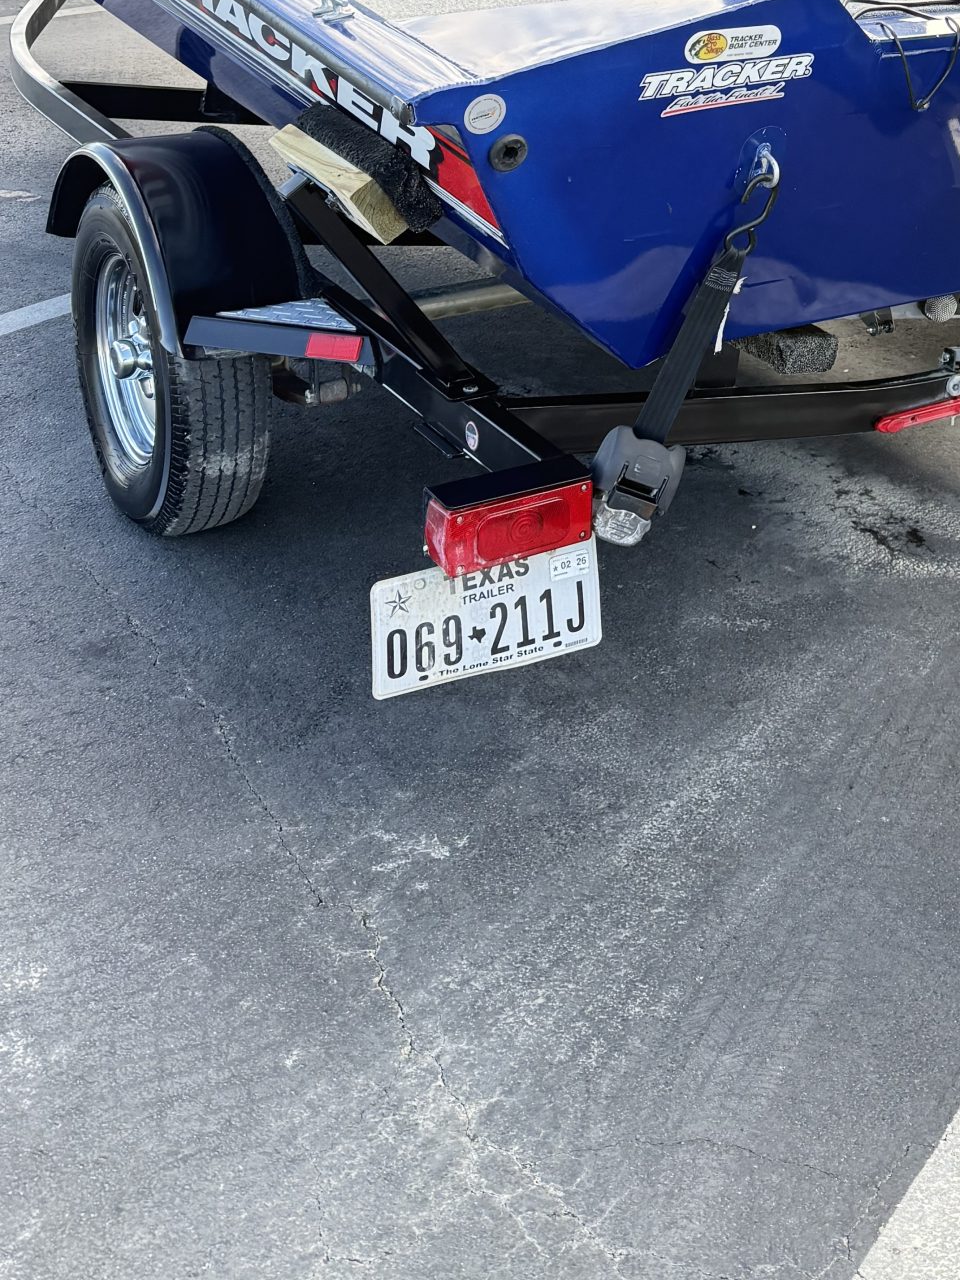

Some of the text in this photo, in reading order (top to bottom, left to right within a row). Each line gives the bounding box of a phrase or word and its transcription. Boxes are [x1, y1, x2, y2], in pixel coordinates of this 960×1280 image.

[728, 39, 778, 50] BOAT CENTER
[730, 34, 763, 43] TRACKER
[560, 560, 572, 570] 02
[444, 556, 530, 595] TEXAS
[462, 583, 515, 606] TRAILER
[439, 646, 544, 677] The Lone Star State
